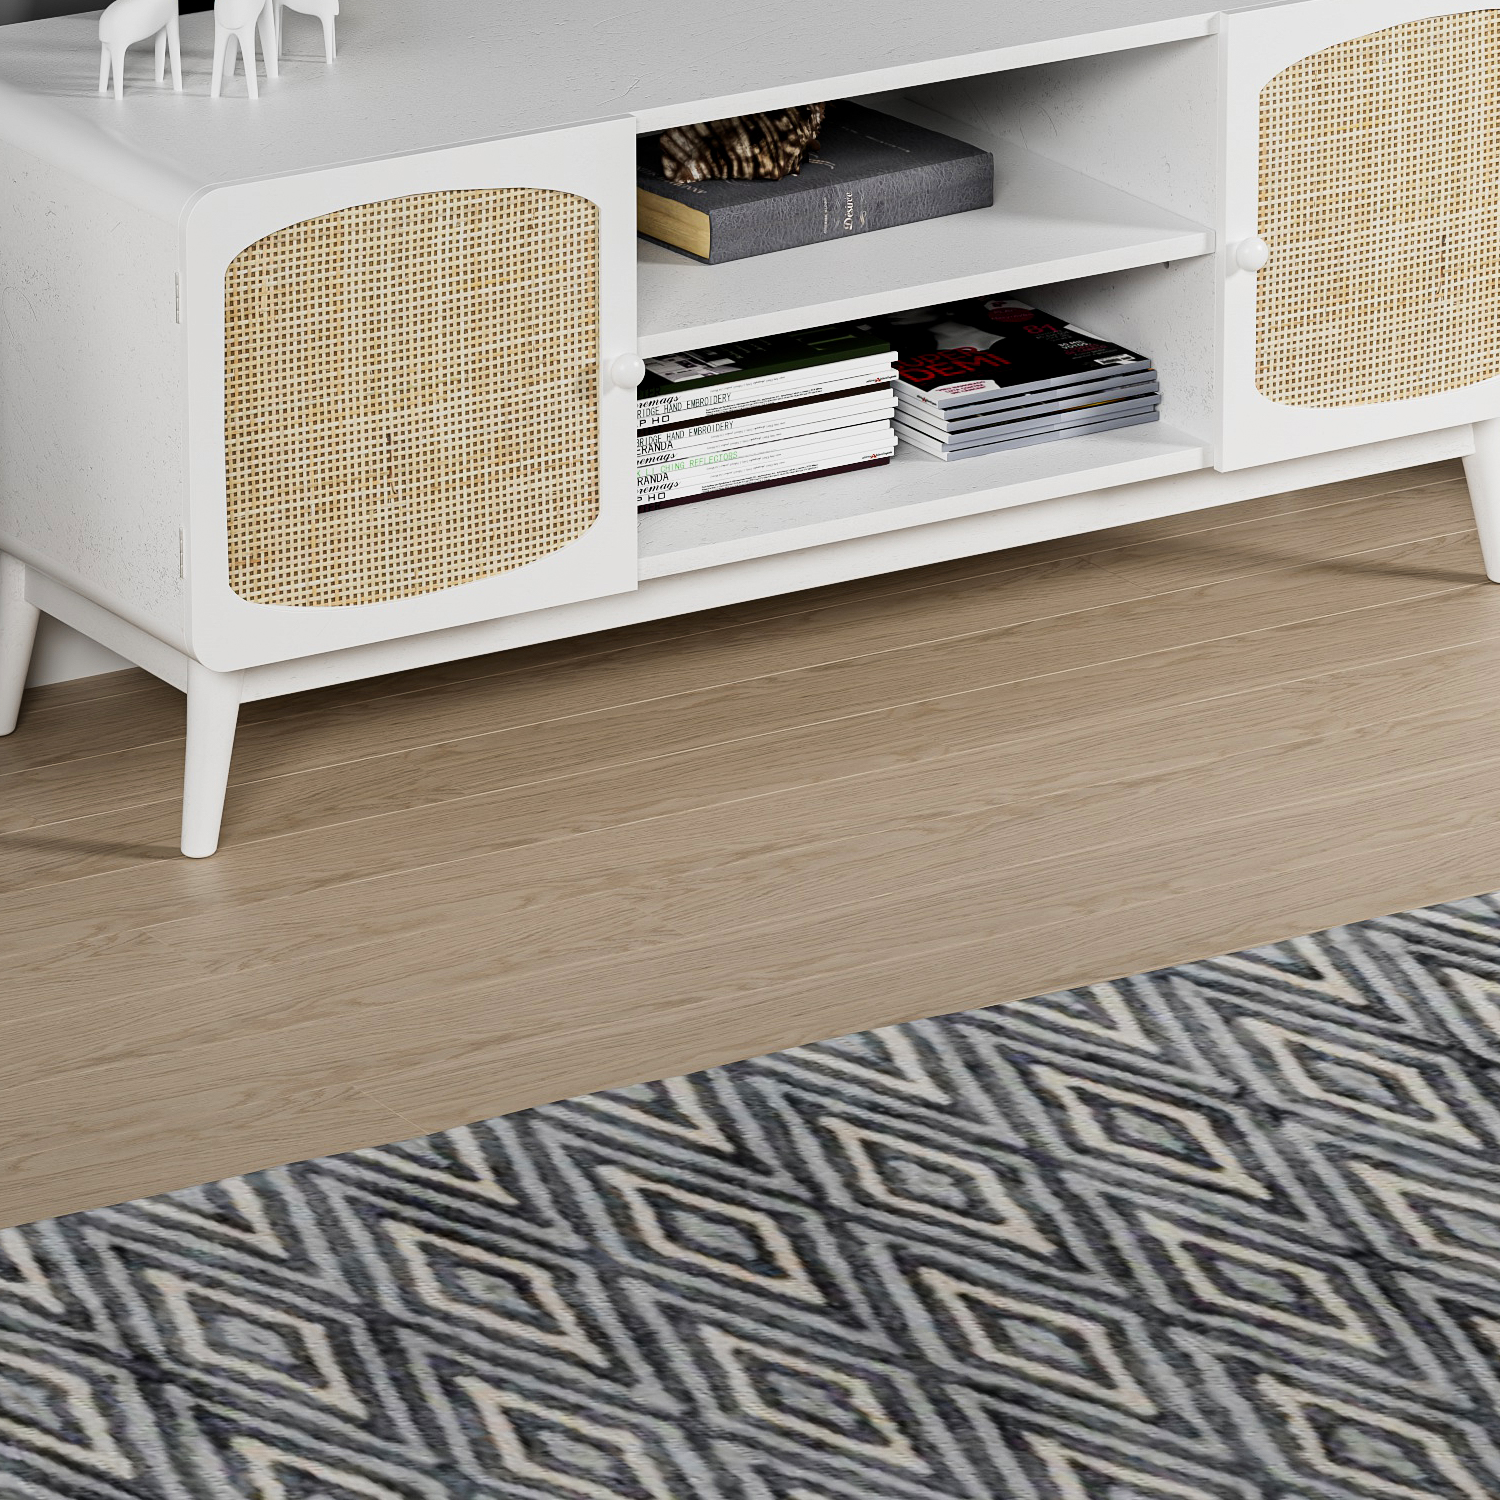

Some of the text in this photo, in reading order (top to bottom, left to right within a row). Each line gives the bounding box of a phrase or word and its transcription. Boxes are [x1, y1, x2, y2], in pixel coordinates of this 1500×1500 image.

[900, 352, 1012, 382] DEMI
[664, 403, 682, 415] HAND
[686, 393, 731, 410] EMBROIDERY
[666, 430, 685, 442] HAND
[688, 421, 734, 437] EMBROIDERY
[660, 462, 685, 474] CHING
[689, 451, 738, 467] REFLECTORS
